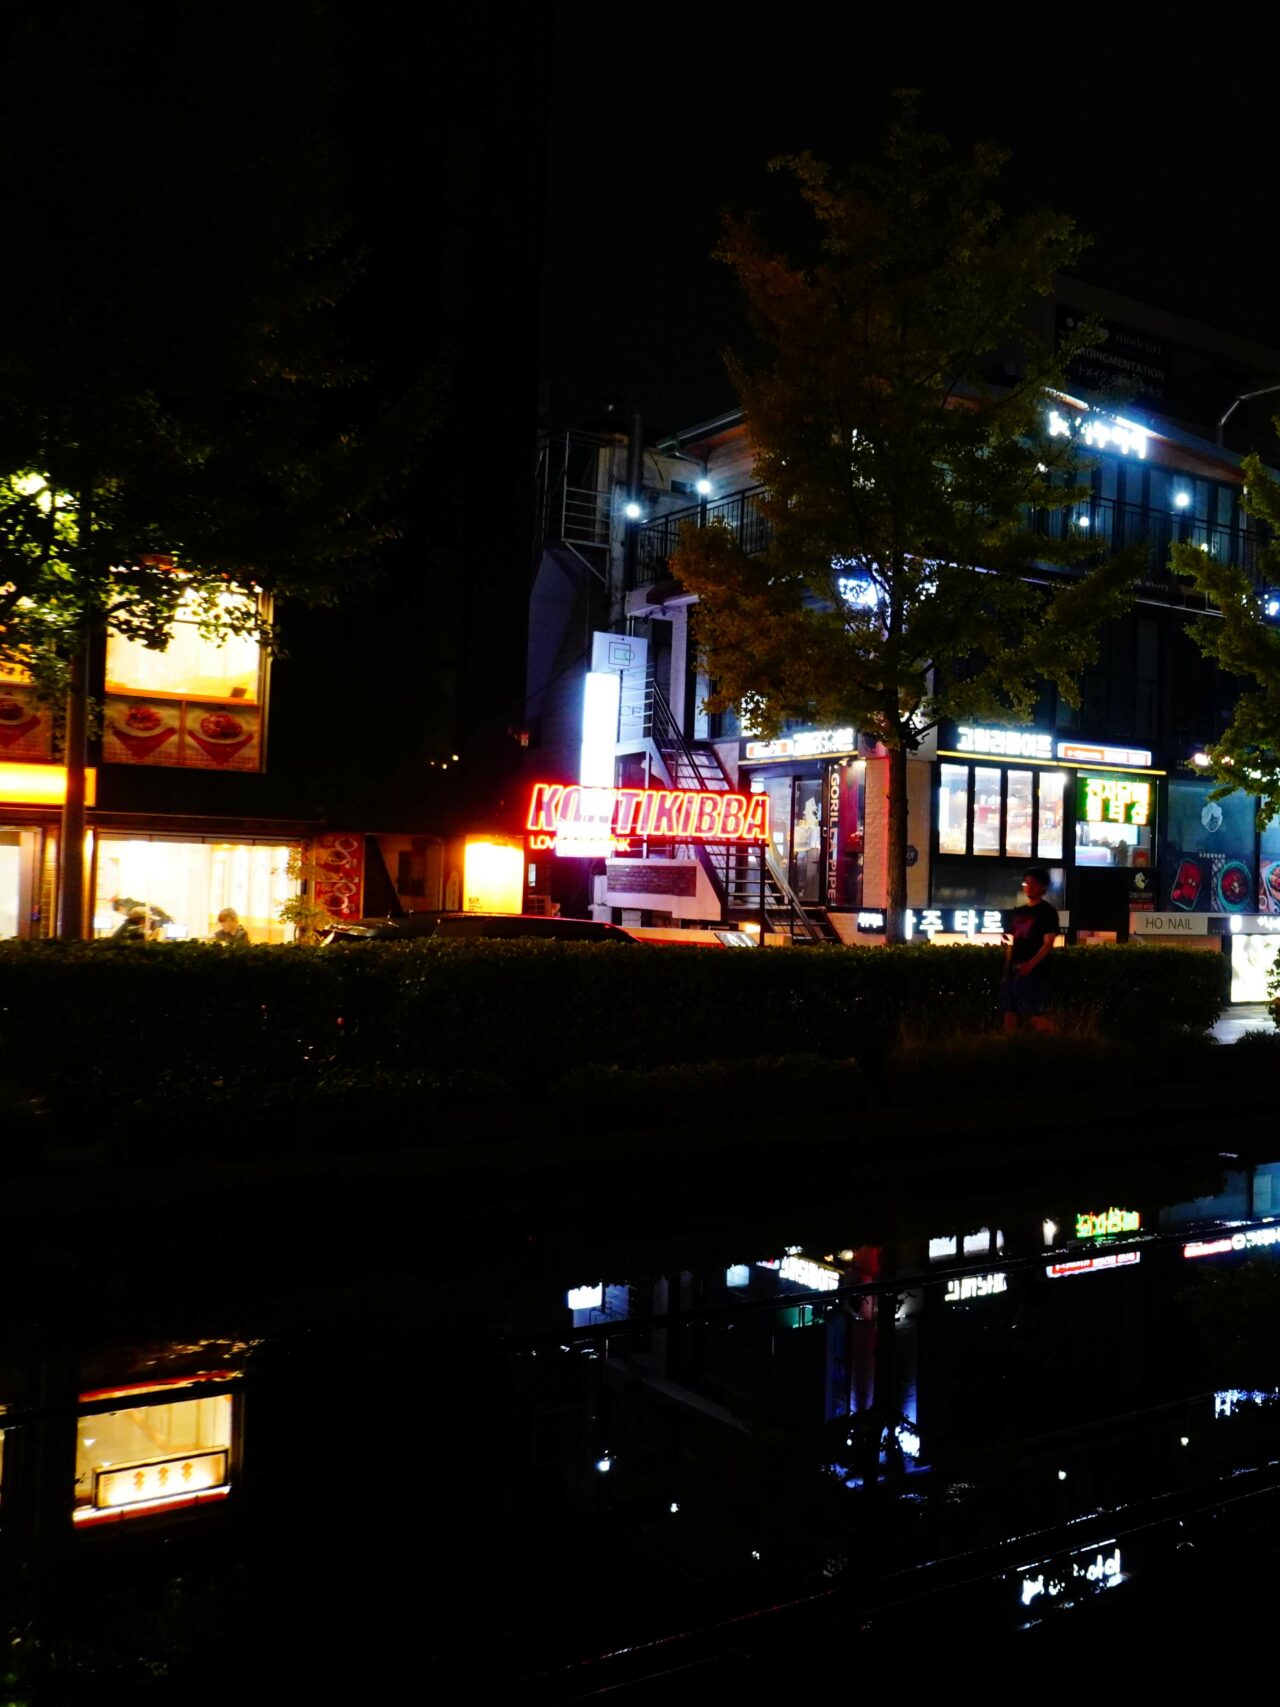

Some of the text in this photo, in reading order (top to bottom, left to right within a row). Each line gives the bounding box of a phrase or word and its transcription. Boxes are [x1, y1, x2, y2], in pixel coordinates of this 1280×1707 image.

[527, 783, 771, 839] KOTIKIBBA
[827, 772, 840, 900] GORILLA PIPE
[953, 909, 1005, 938] 타로
[1145, 917, 1193, 931] HO NAIL
